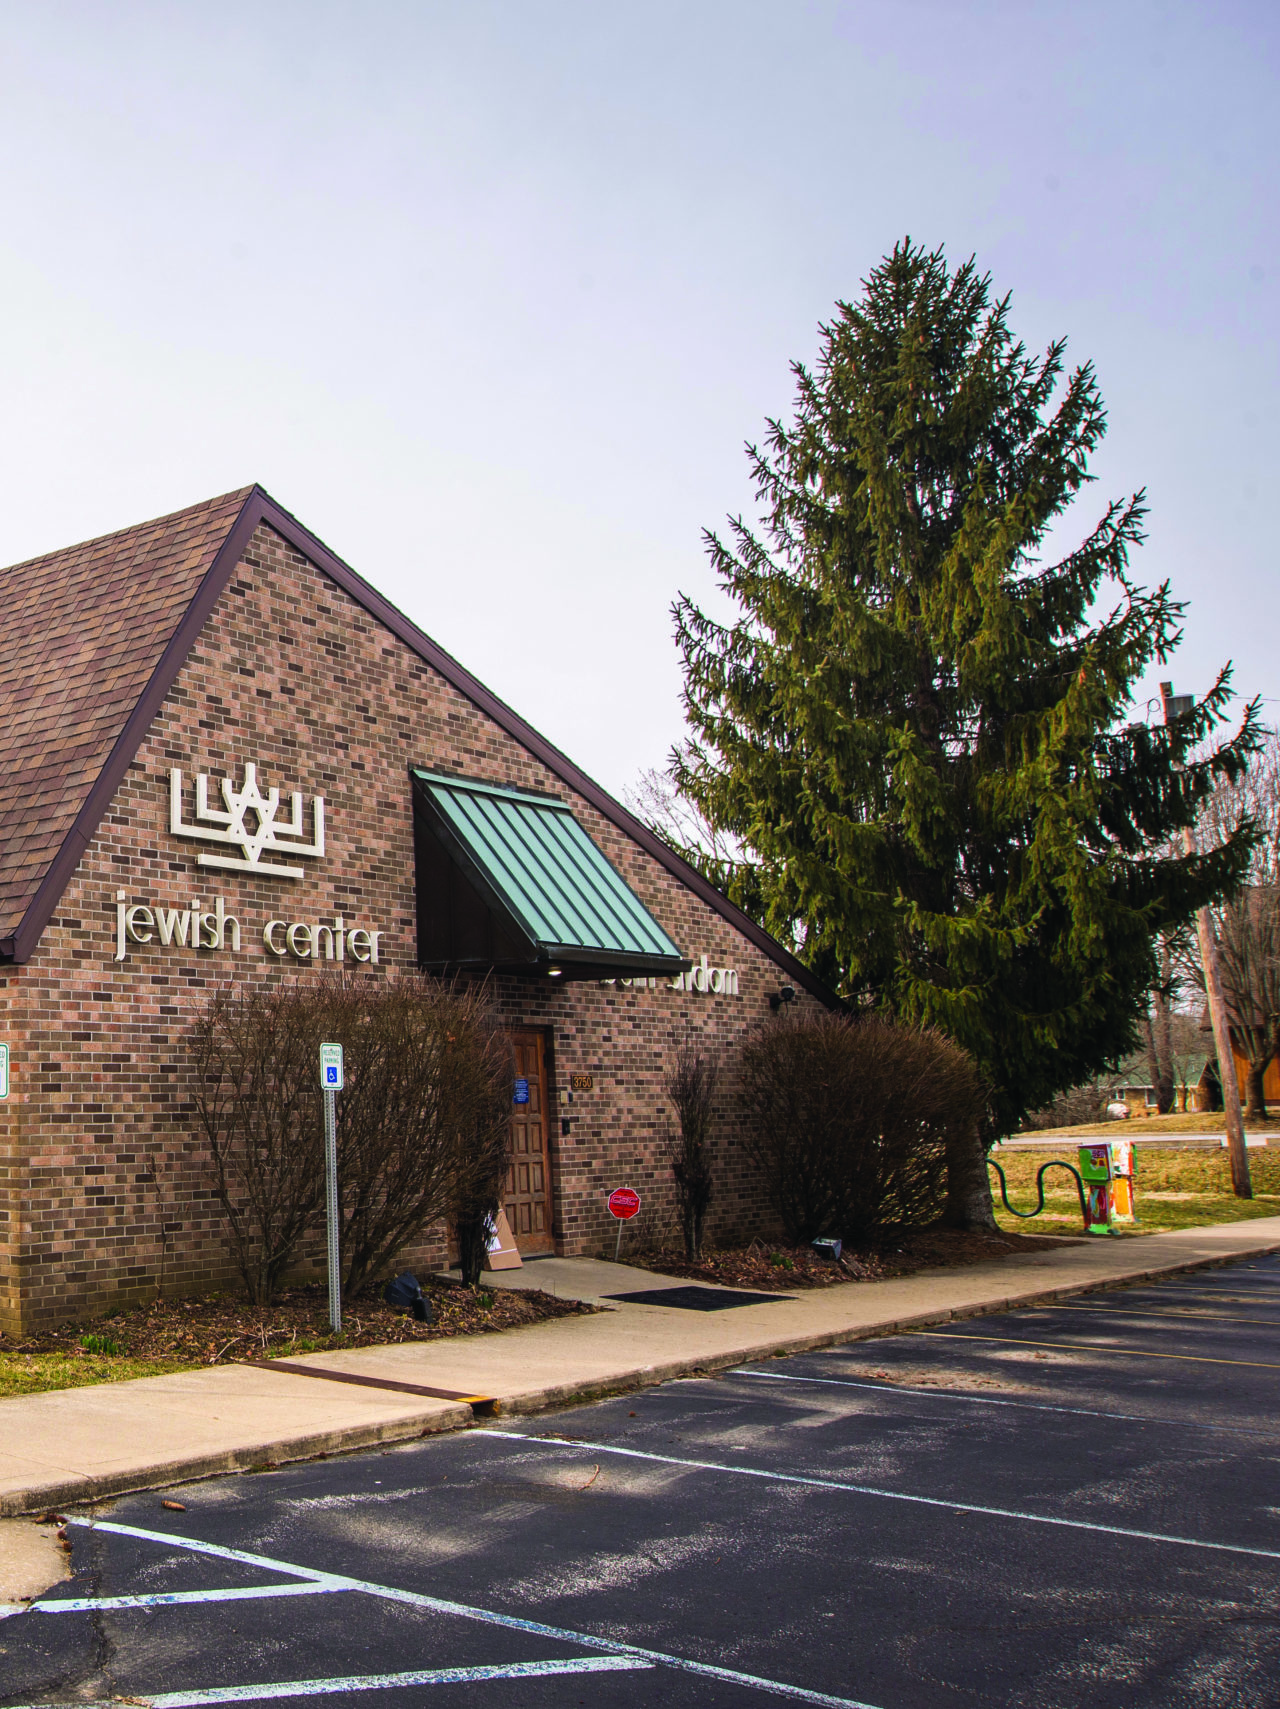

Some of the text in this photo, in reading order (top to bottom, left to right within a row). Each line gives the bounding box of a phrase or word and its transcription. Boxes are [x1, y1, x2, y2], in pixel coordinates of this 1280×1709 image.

[115, 890, 384, 964] jewish center
[574, 1076, 592, 1088] 3750
